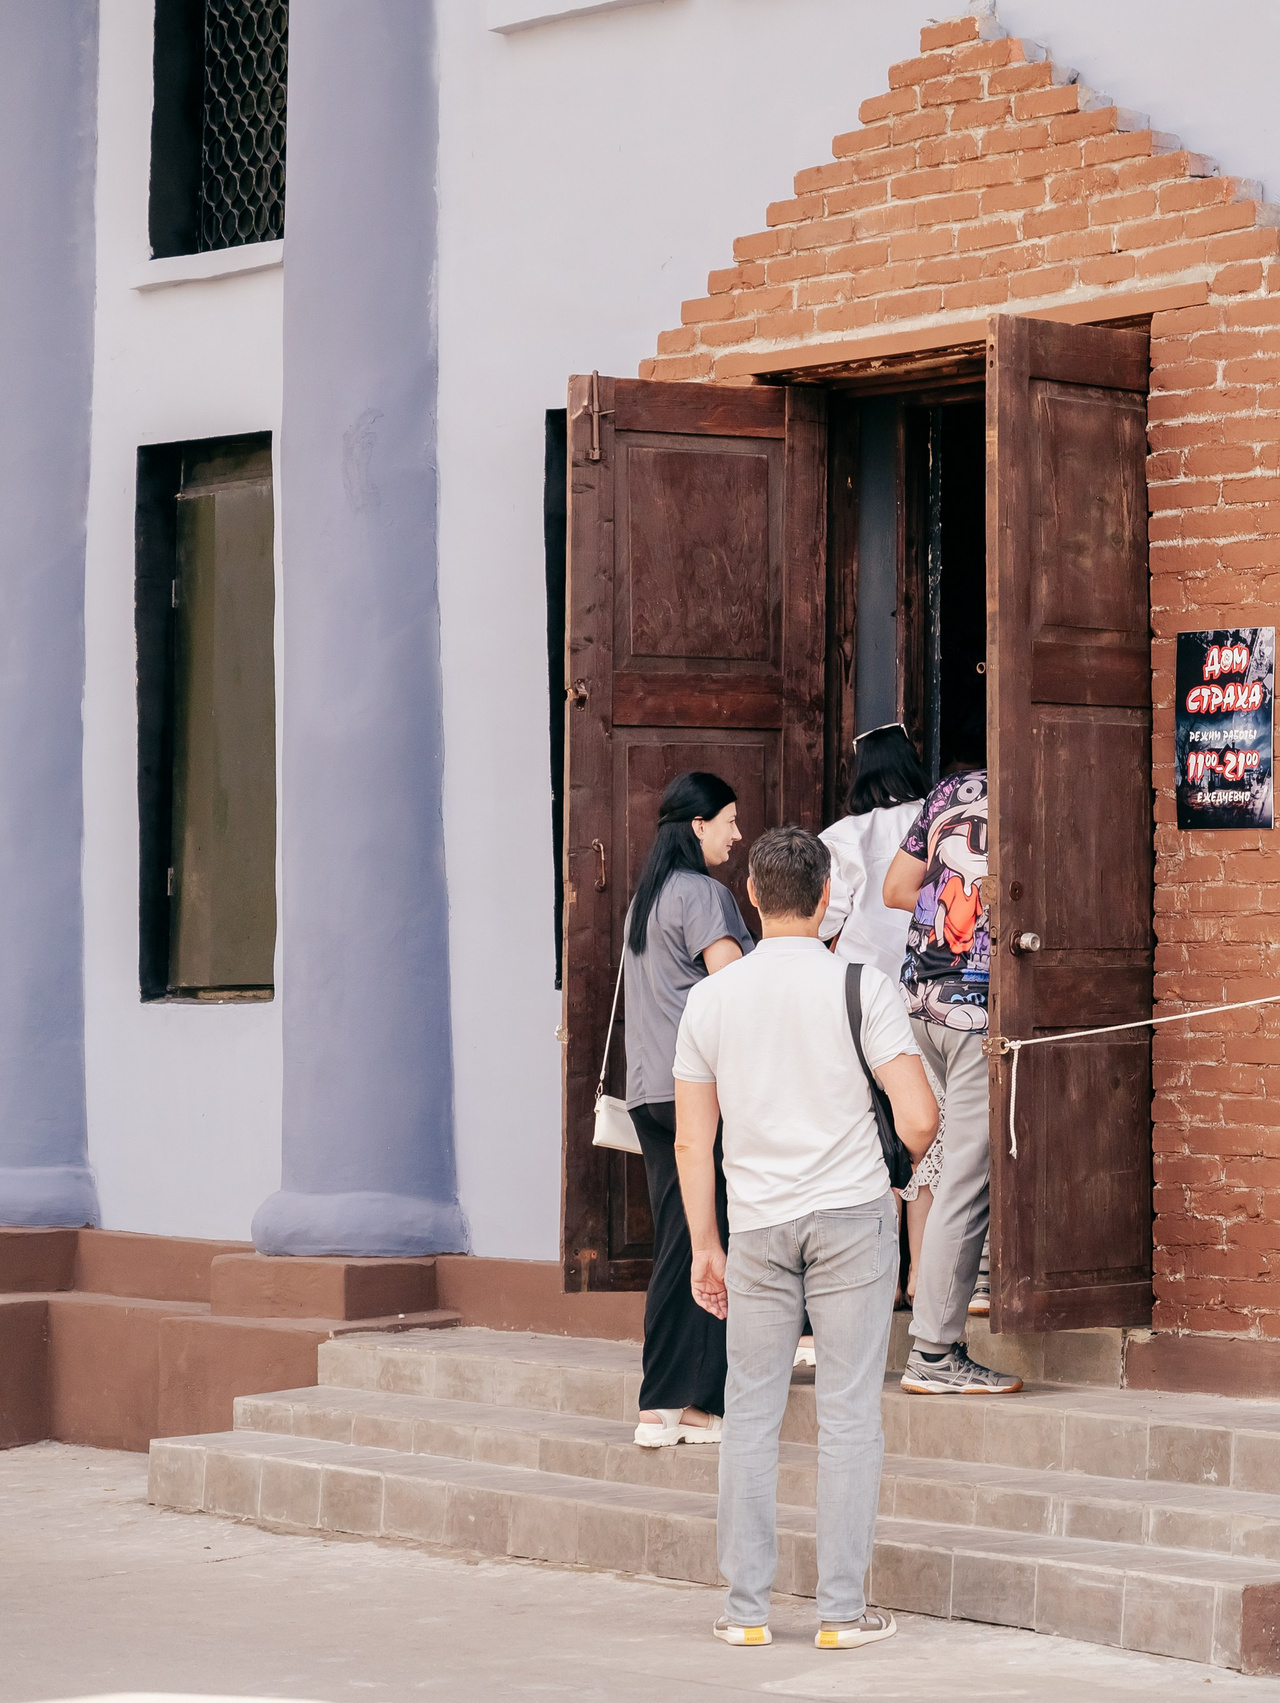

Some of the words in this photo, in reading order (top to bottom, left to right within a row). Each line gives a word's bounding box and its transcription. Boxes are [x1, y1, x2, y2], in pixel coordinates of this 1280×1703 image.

[1204, 645, 1249, 679] ДОМ
[1187, 682, 1262, 714] СТРАХА
[1189, 731, 1220, 742] РЕЖИМ
[1222, 729, 1257, 741] РАБОТЫ
[1197, 791, 1250, 803] ЕЖЕДНЕВНО
